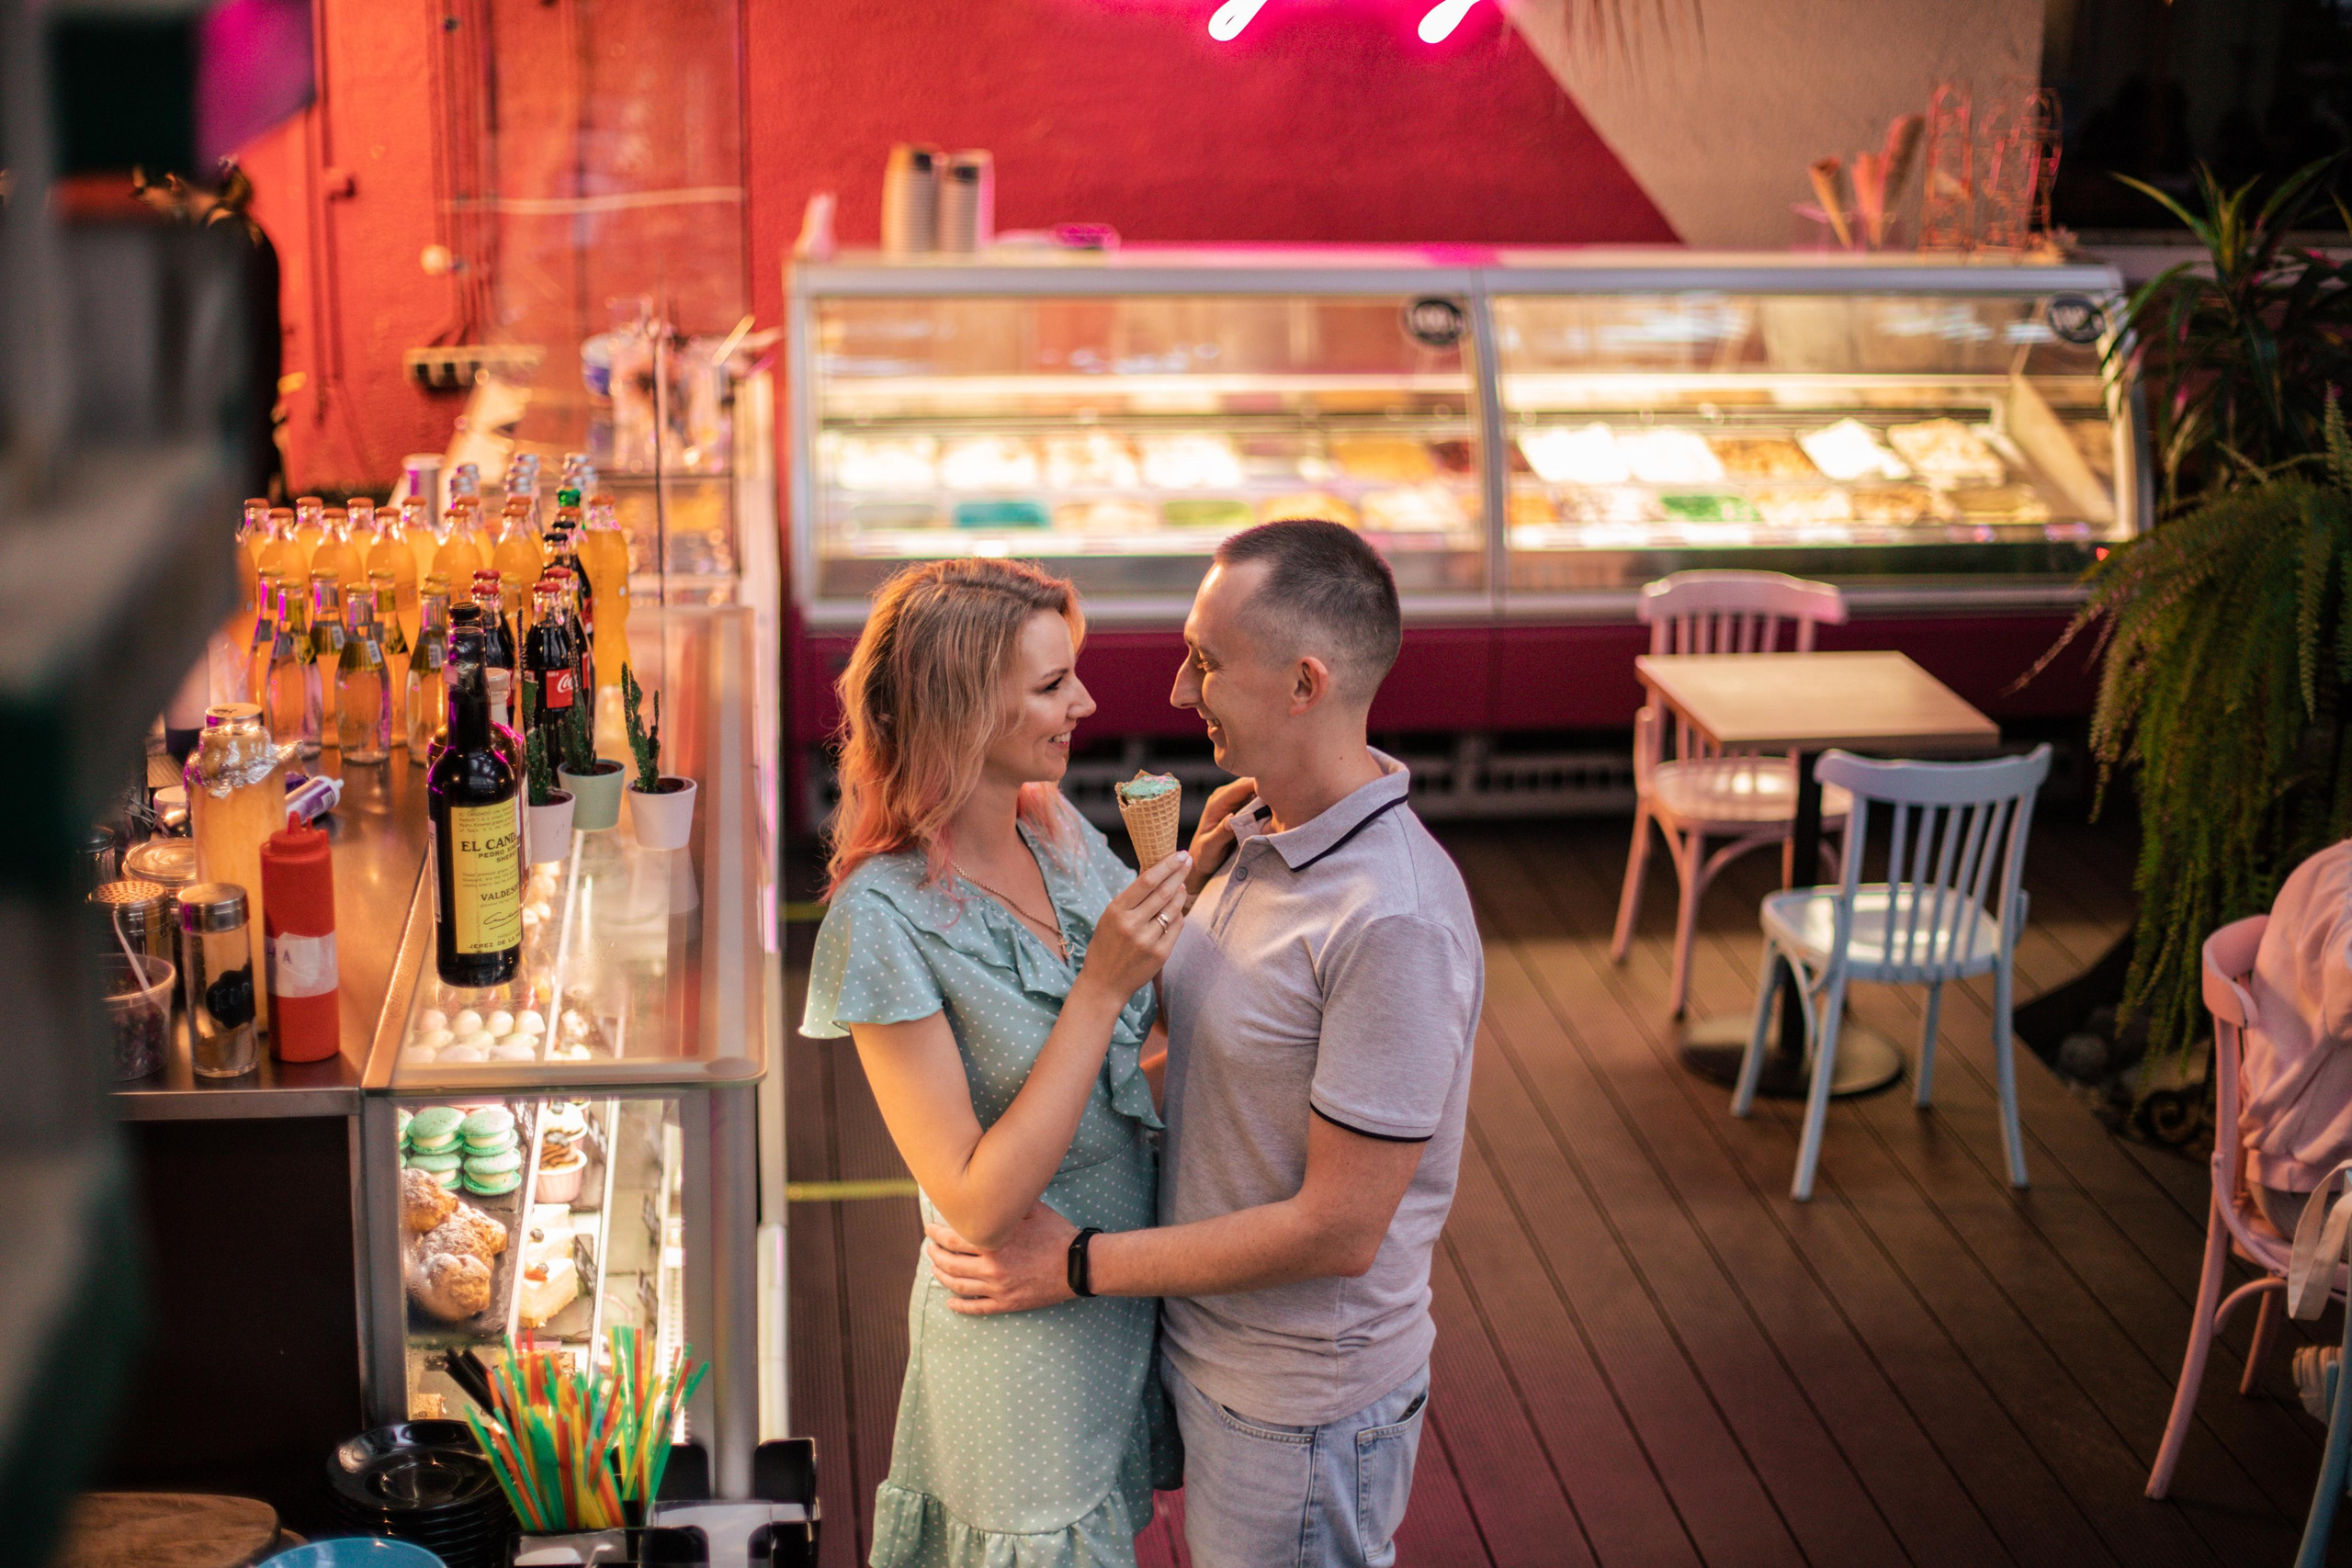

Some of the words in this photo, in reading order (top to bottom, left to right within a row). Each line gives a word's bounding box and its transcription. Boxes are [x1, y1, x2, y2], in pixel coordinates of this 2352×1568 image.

[461, 840, 481, 852] EL
[485, 831, 516, 850] CAND
[478, 849, 504, 859] PEDRO
